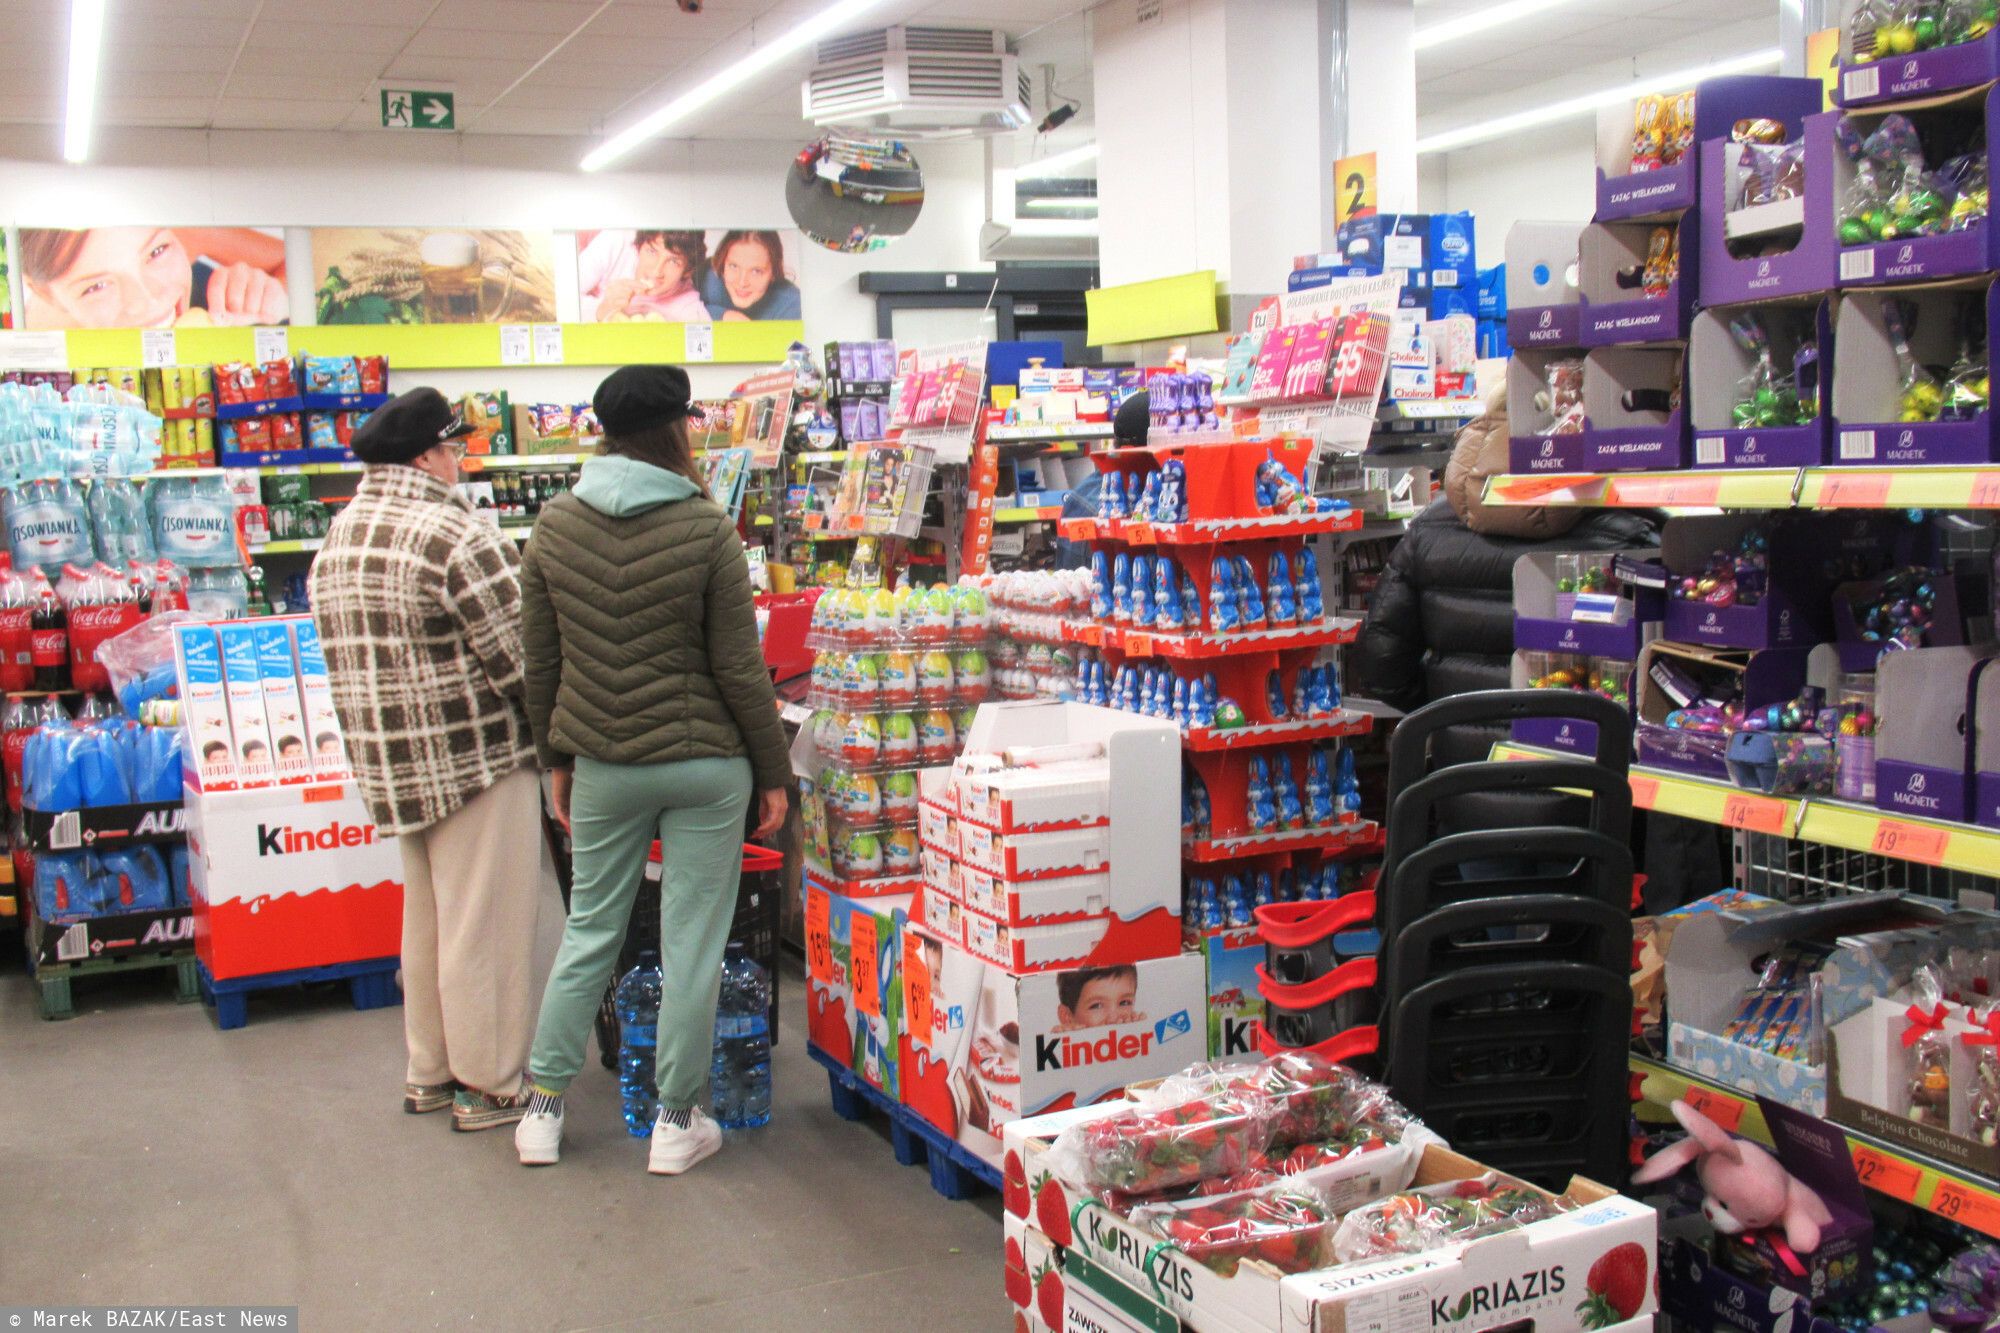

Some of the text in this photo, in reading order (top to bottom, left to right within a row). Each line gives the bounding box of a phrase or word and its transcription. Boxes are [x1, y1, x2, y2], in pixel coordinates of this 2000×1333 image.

[1891, 77, 1931, 93] MAGNETIC
[1345, 173, 1366, 215] 2
[1886, 263, 1924, 276] MAGNETIC
[1529, 329, 1561, 340] MAGNETIC
[1395, 387, 1433, 398] Cholinex
[1887, 449, 1926, 460] MAGNETIC
[1530, 458, 1564, 469] MAGNETIC
[162, 517, 229, 534] CISOWIANKA
[1893, 793, 1940, 809] MAGNETIC
[258, 822, 376, 856] Kinder
[1035, 1030, 1153, 1072] Kinder
[1908, 1126, 1969, 1157] Chocolate
[1488, 1296, 1565, 1323] company
